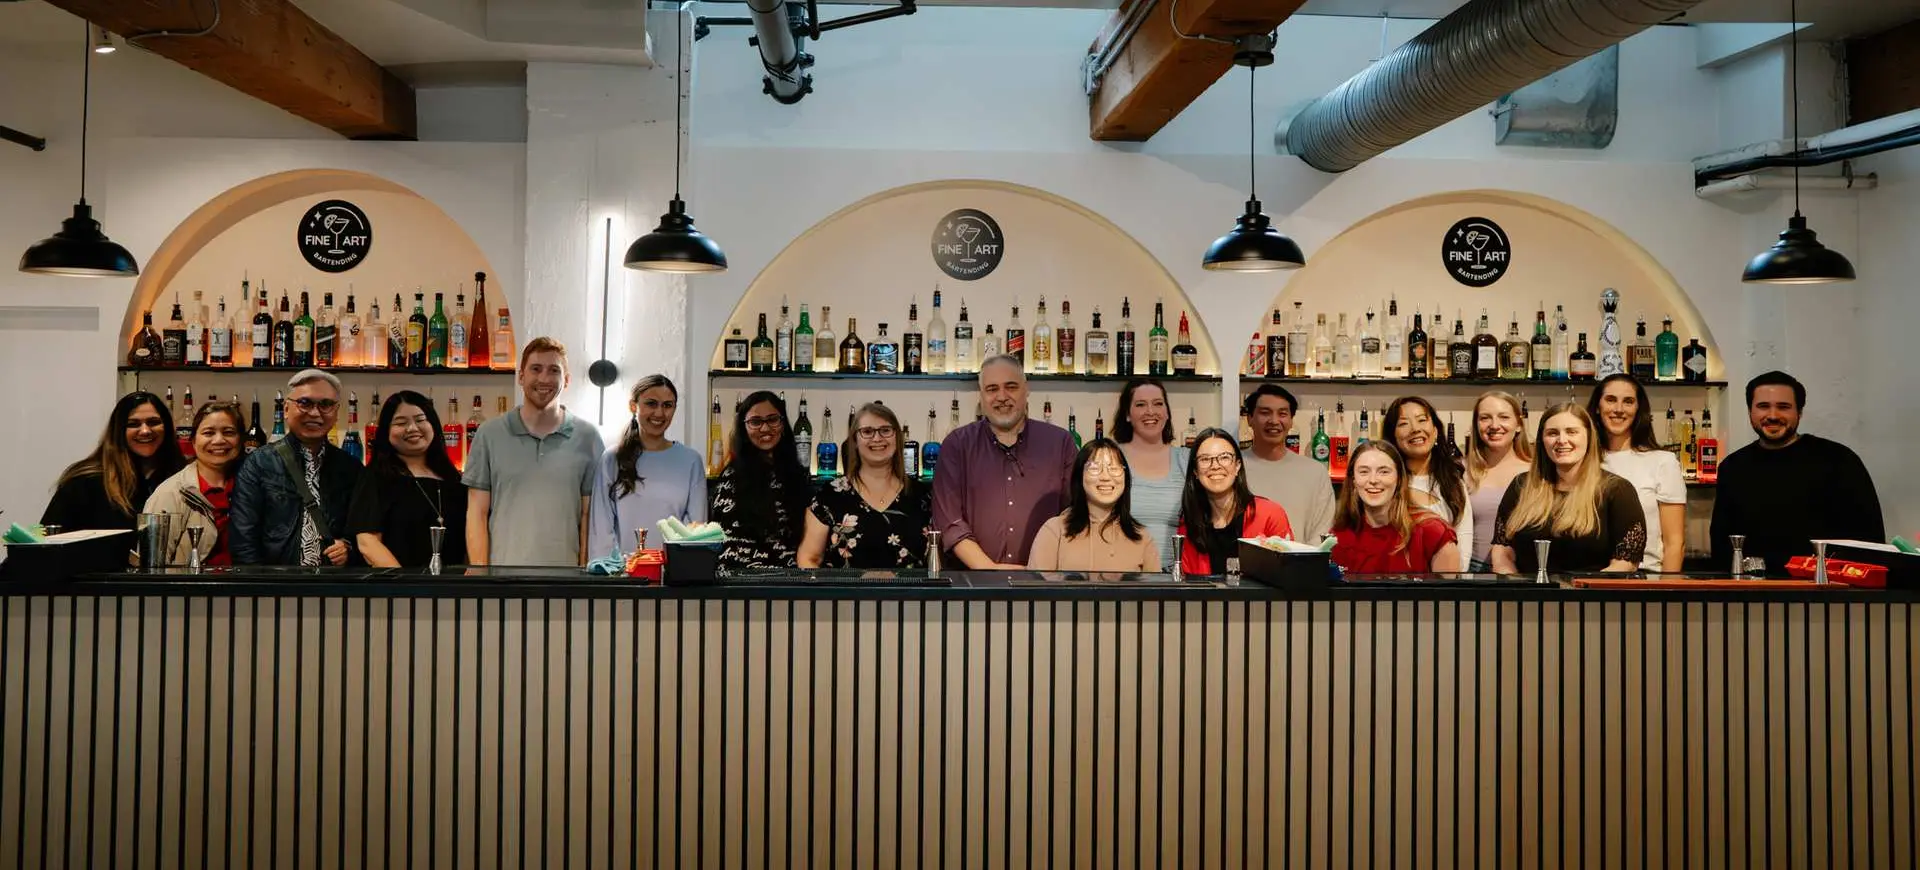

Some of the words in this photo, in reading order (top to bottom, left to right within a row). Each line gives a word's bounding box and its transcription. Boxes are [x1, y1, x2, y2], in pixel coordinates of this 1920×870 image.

[305, 235, 330, 246] FINE
[342, 235, 367, 246] ART
[937, 244, 963, 255] FINE
[974, 244, 999, 255] ART
[313, 251, 358, 266] BARTENDING
[1449, 251, 1473, 261] FINE
[1484, 251, 1507, 261] ART
[946, 261, 989, 274] BARTENDING
[1457, 267, 1499, 280] BARTENDING
